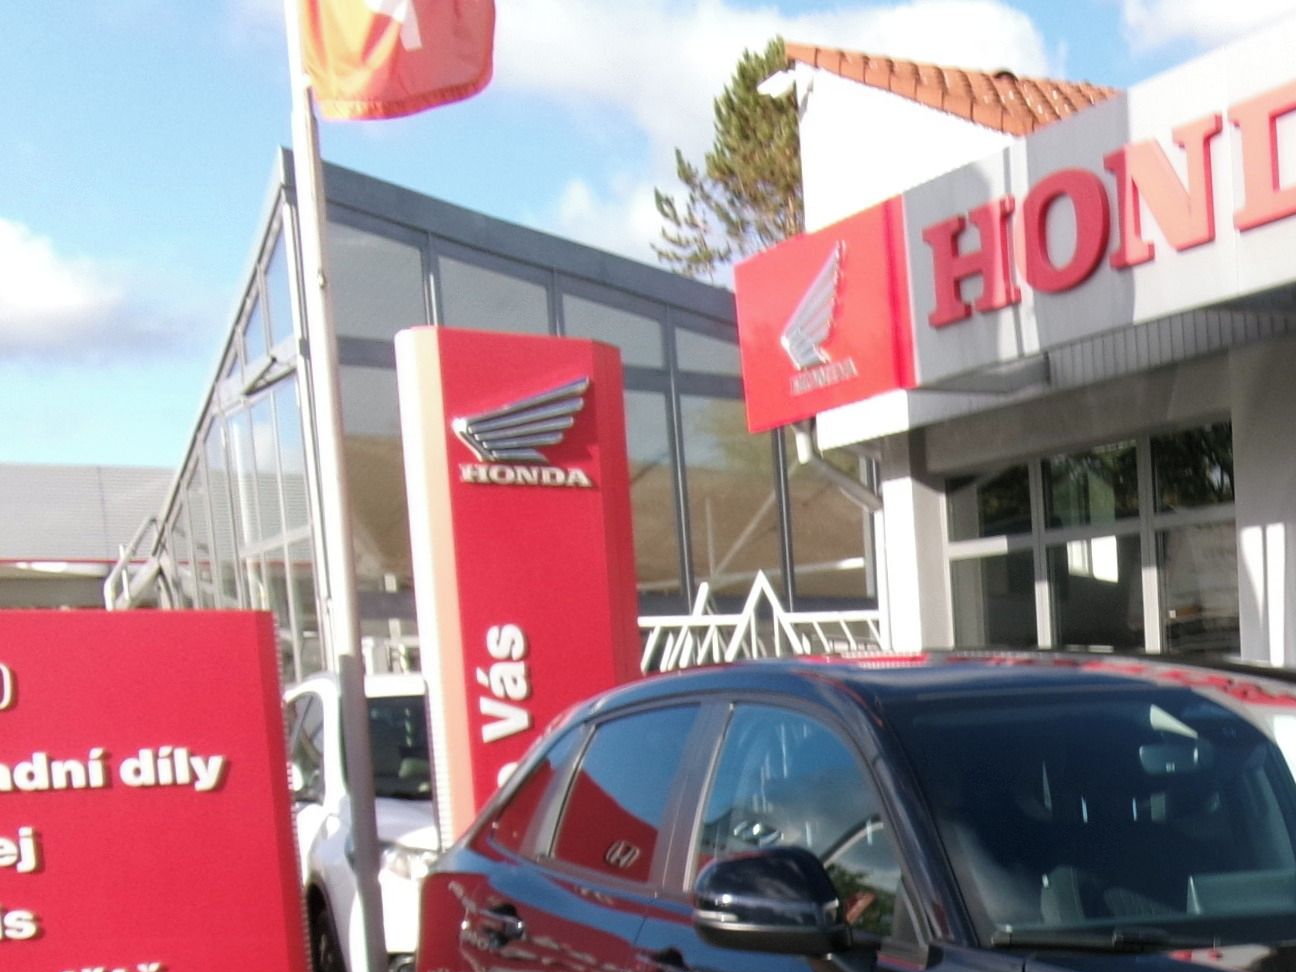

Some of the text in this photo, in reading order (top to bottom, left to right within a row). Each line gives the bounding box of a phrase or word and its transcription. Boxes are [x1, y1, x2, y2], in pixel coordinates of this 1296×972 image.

[458, 463, 593, 488] HONDA
[476, 624, 531, 744] Vás
[120, 746, 223, 791] díly
[0, 906, 37, 940] s
